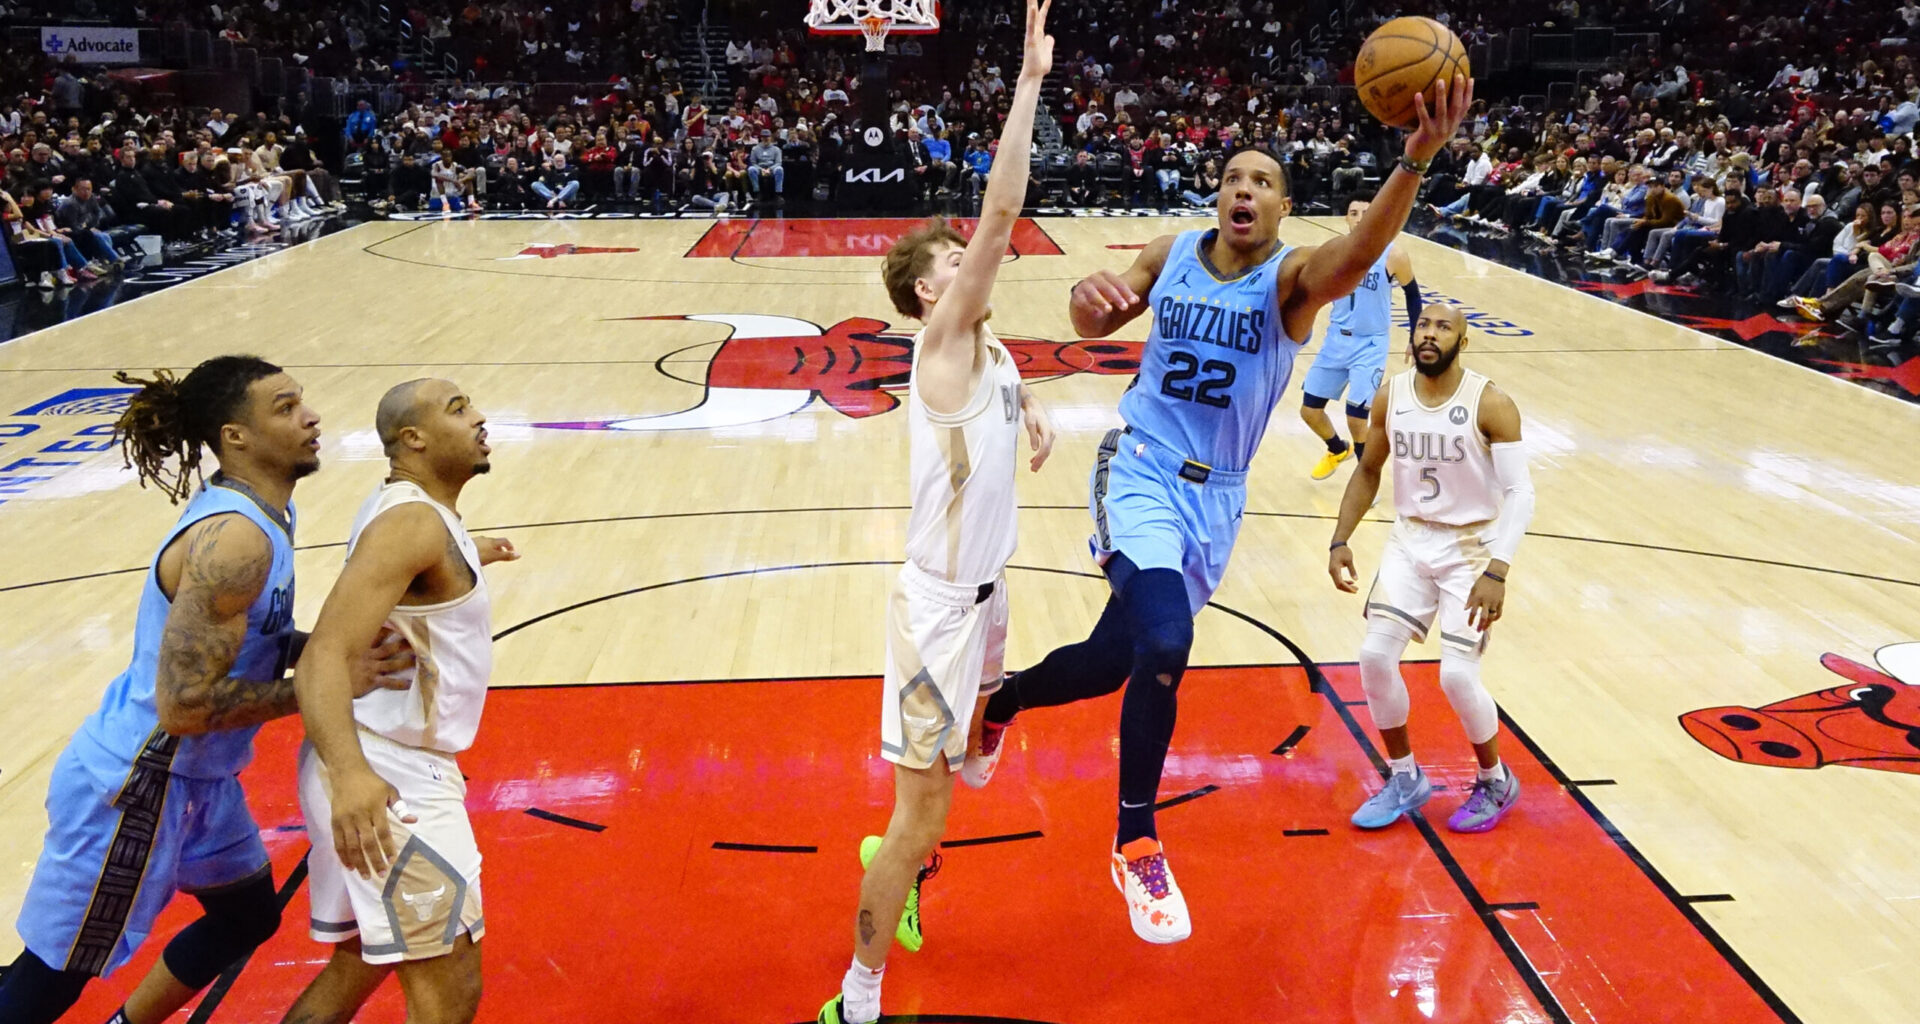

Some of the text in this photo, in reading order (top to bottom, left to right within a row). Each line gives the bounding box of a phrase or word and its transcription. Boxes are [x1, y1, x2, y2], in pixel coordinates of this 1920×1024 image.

[67, 37, 134, 53] Advocate
[845, 167, 905, 183] KIA
[1159, 296, 1265, 355] GRIZZLIES
[1160, 350, 1237, 410] 22
[1393, 429, 1466, 464] BULLS
[1420, 467, 1441, 503] 5
